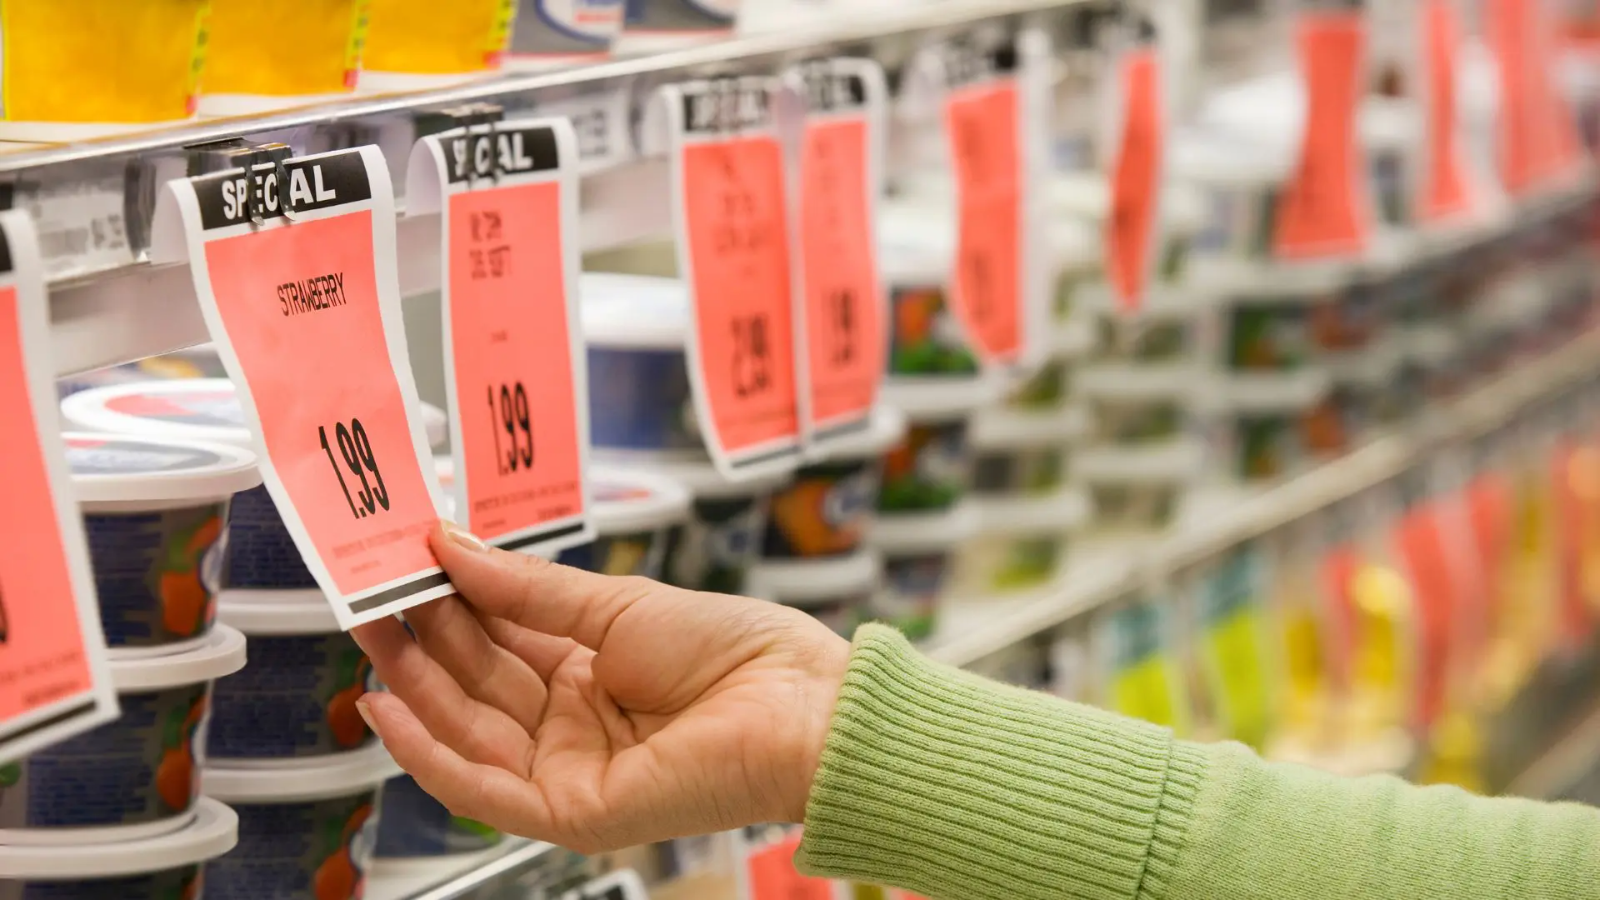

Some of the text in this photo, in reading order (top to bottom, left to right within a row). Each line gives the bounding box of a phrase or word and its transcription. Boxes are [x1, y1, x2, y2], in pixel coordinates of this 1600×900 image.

[221, 164, 336, 220] SPECAL
[277, 272, 348, 317] STRAWBERRY
[488, 381, 533, 475] 1.99
[318, 418, 390, 519] 1.99
